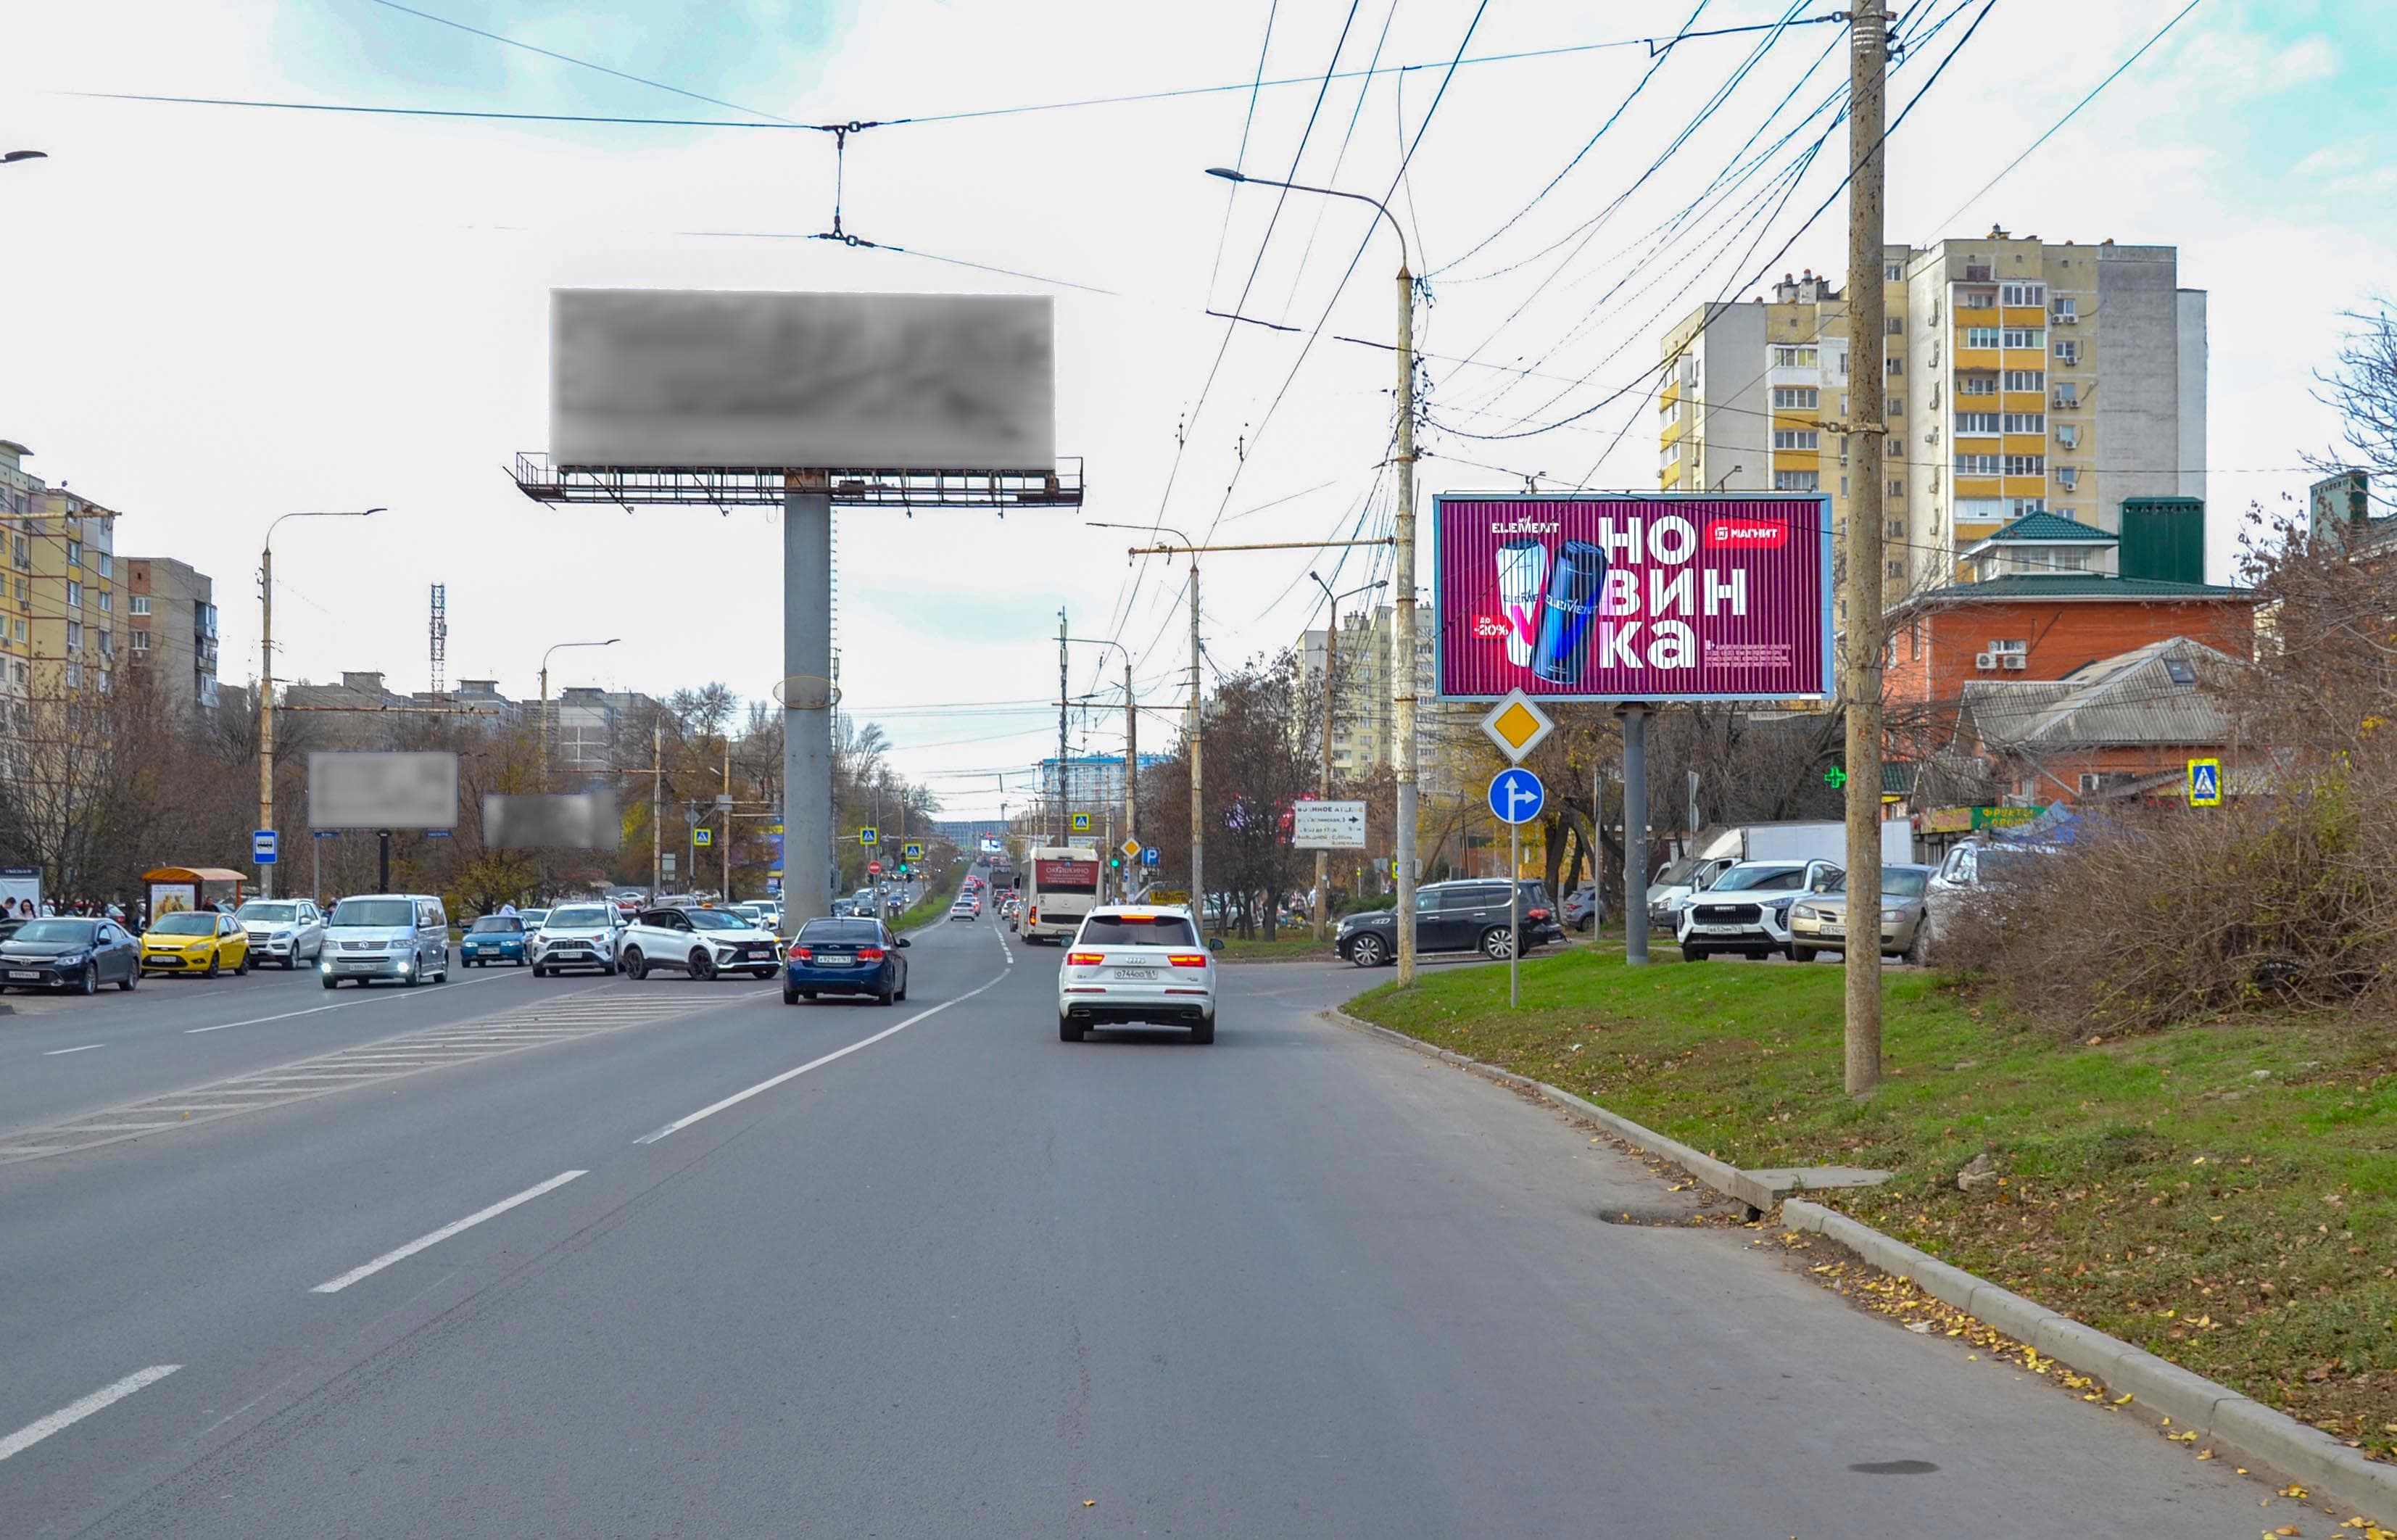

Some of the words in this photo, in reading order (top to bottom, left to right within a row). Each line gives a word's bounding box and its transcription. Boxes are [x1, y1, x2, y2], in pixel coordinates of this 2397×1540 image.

[1491, 516, 1559, 534] ELEMENT
[1731, 529, 1778, 538] МАГНИТ
[1599, 516, 1697, 565] НО
[1599, 568, 1746, 617] ВИН
[1473, 624, 1509, 636] -20%
[1148, 849, 1158, 865] P
